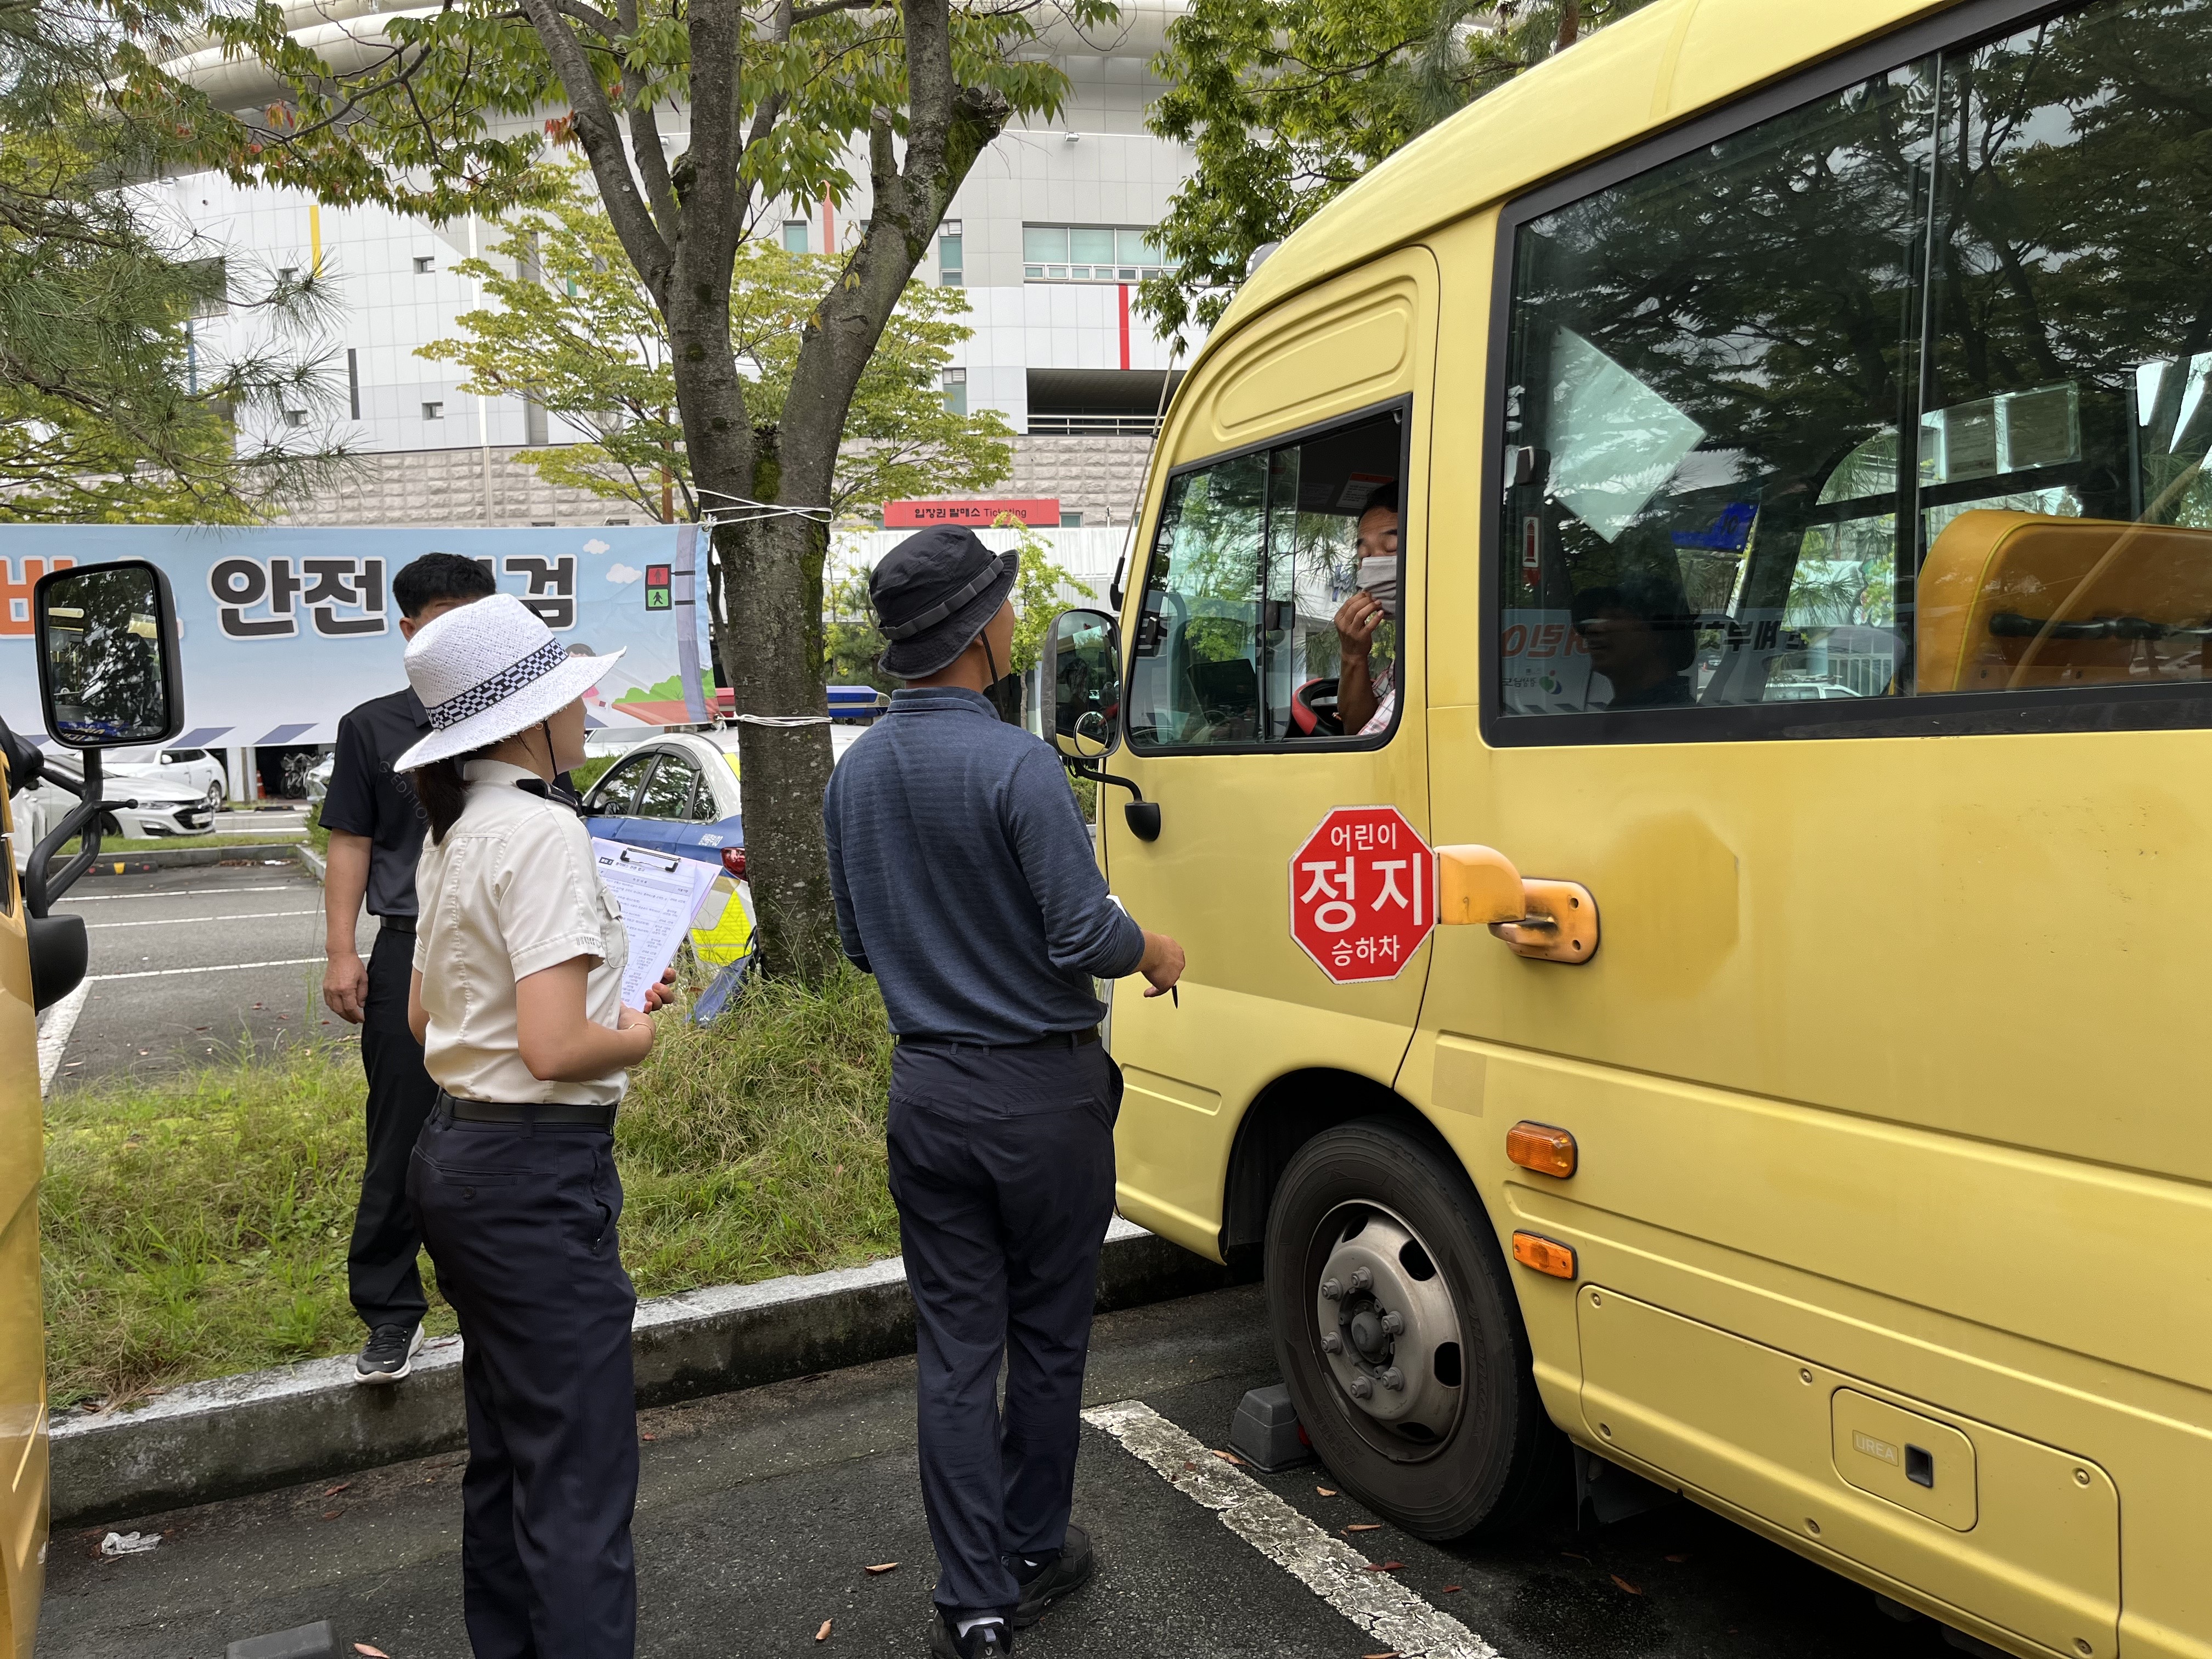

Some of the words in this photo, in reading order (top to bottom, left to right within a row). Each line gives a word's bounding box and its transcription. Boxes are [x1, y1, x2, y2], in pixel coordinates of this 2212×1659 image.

[915, 509, 946, 518] 입장권
[950, 507, 980, 518] 발매소
[211, 558, 385, 636] 안전
[477, 557, 574, 628] 검
[1330, 822, 1397, 853] 어린이
[1299, 852, 1423, 933] 정지
[1331, 934, 1401, 967] 승하차
[1855, 1435, 1896, 1462] UREA
